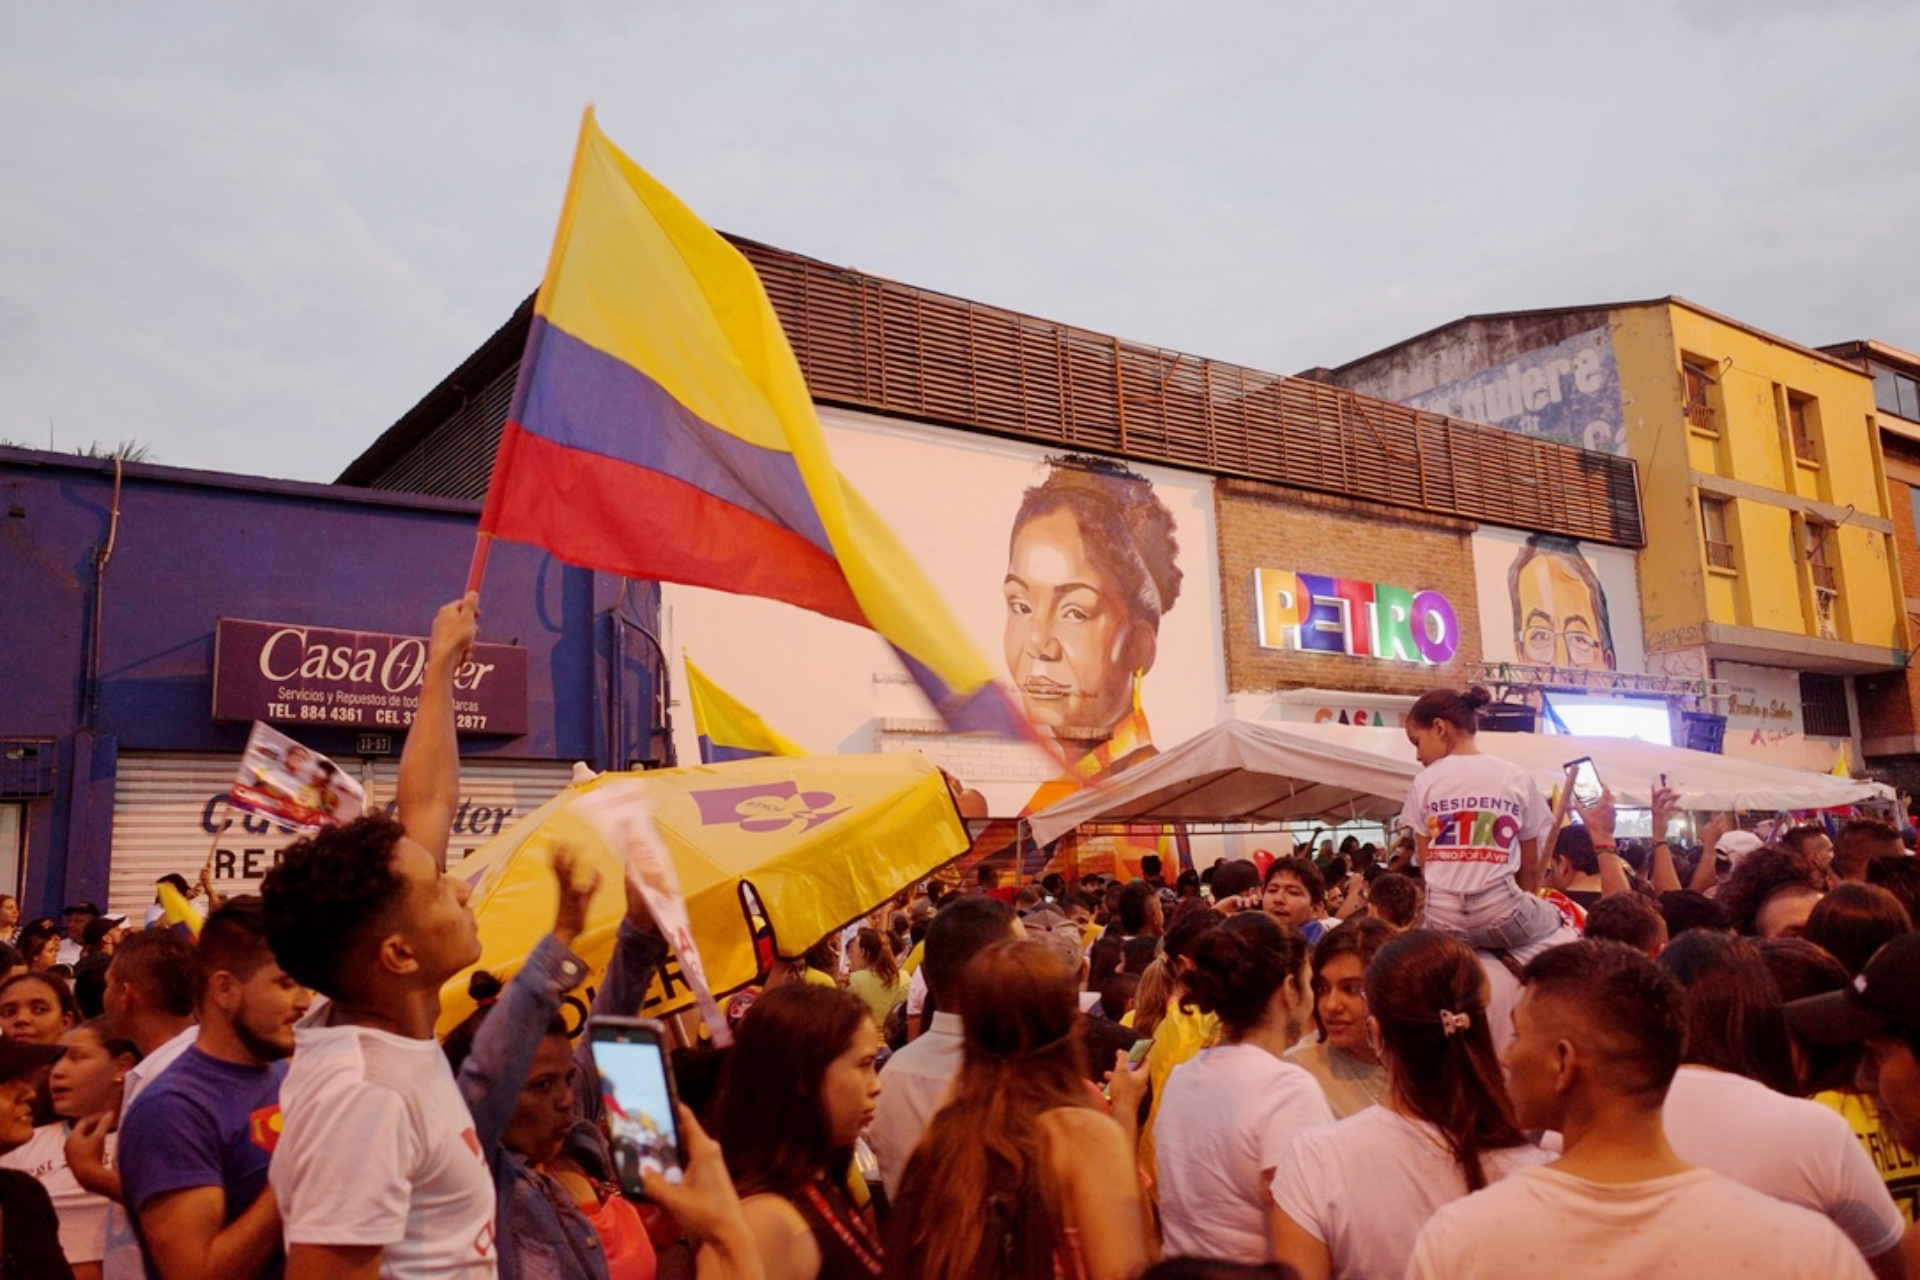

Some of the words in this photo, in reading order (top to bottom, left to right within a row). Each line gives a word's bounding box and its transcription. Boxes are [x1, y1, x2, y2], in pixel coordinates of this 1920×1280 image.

[1254, 566, 1460, 666] PETRO
[259, 628, 377, 684] Casa
[380, 638, 495, 694] Oer
[267, 703, 296, 720] TEL.
[300, 705, 327, 720] 884
[330, 707, 363, 722] 4361
[376, 709, 400, 725] CEL
[457, 714, 487, 729] 2877
[277, 685, 325, 701] Servicios
[326, 691, 333, 706] y
[336, 690, 386, 707] Repuestos
[389, 694, 401, 707] de
[402, 695, 418, 709] tod
